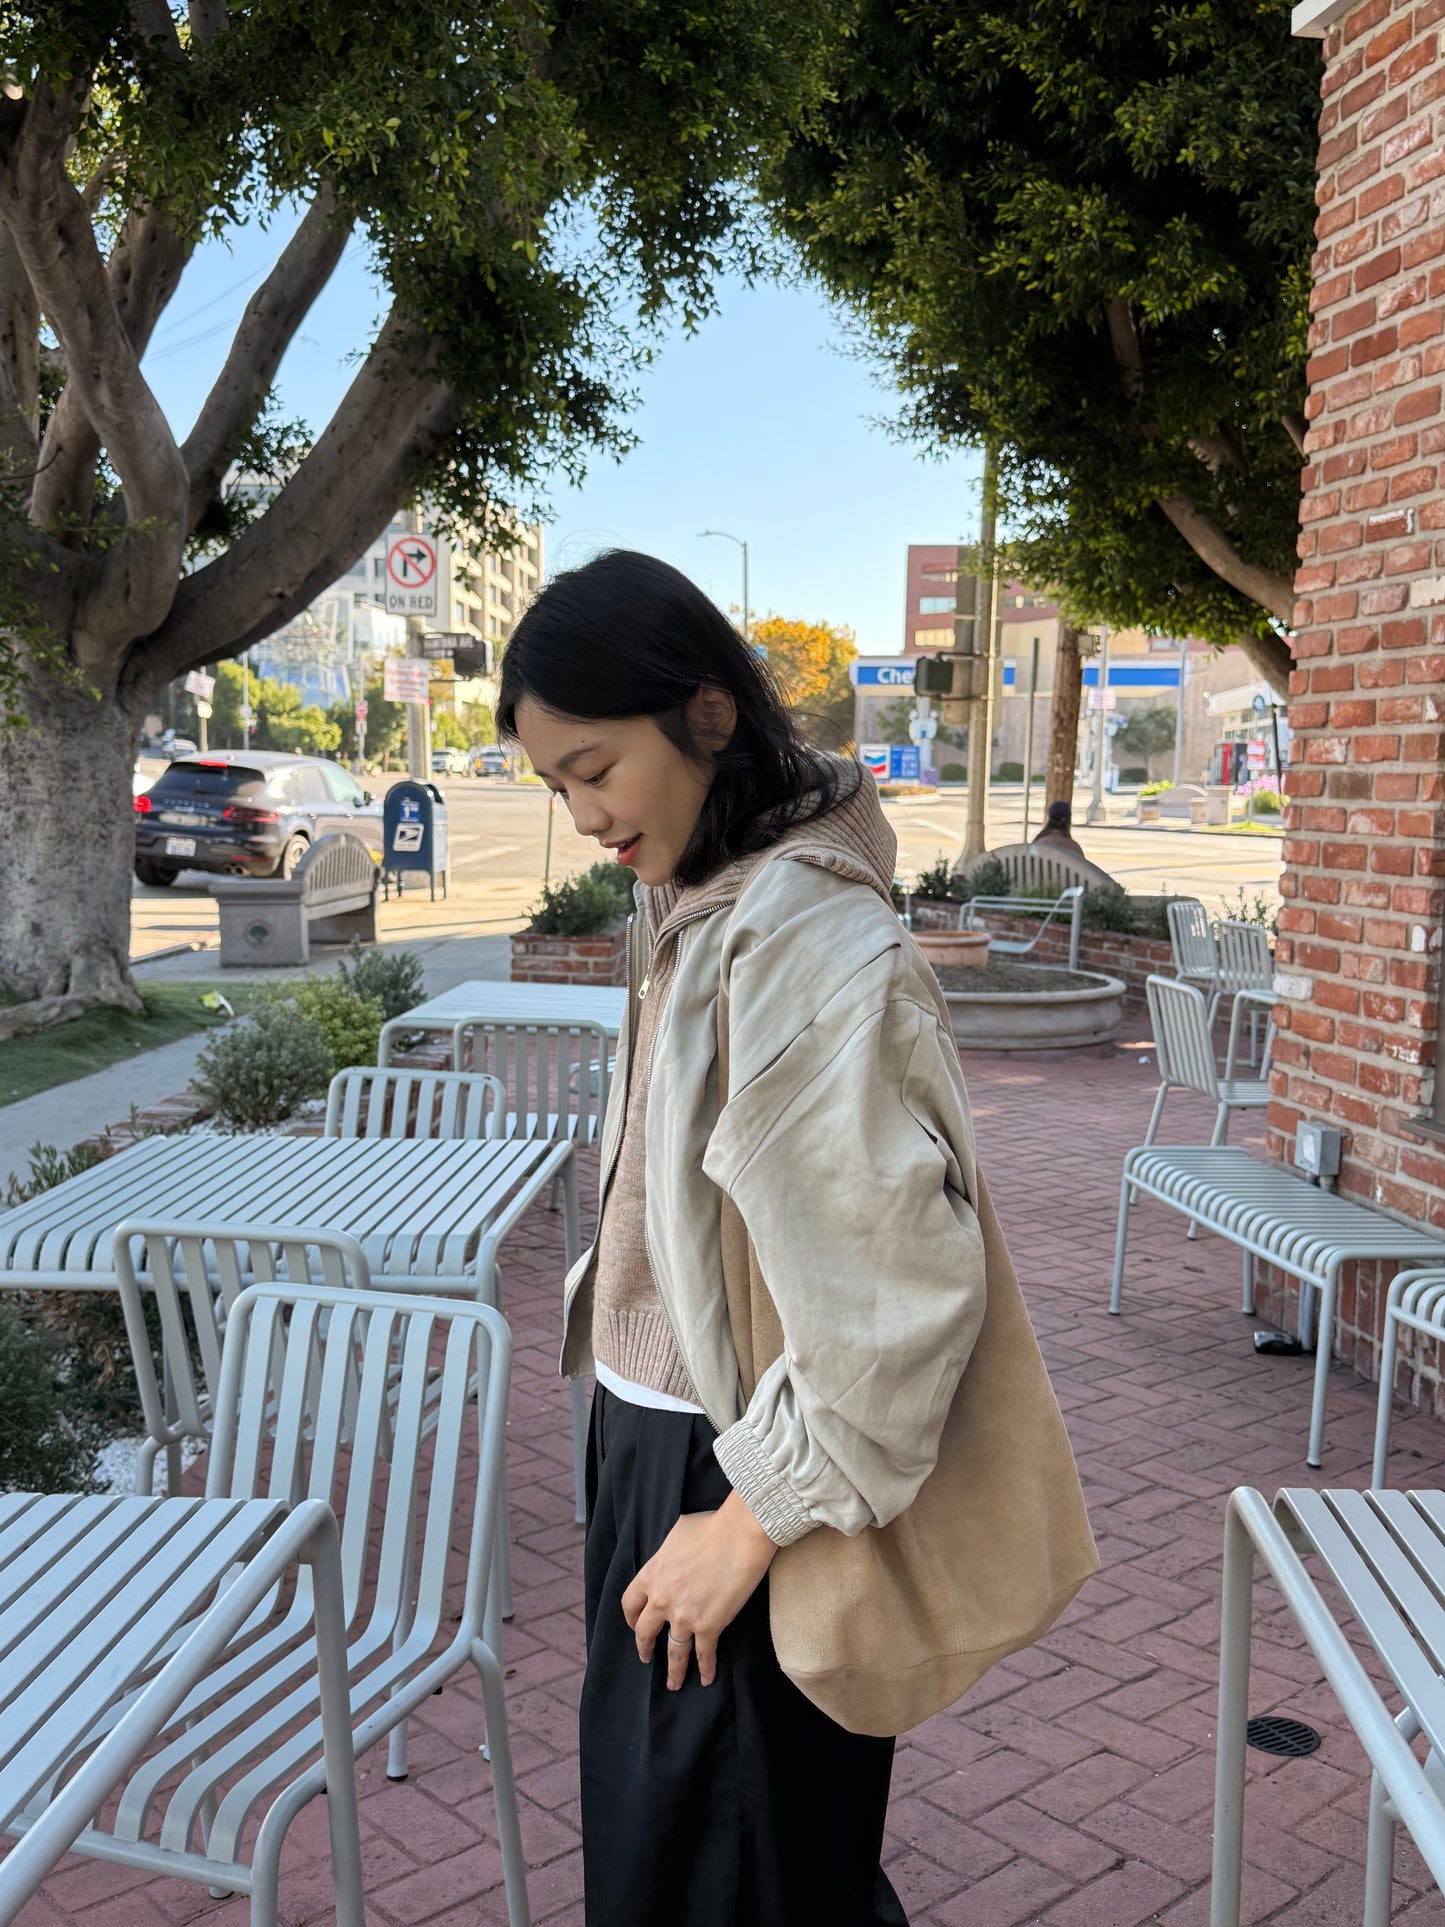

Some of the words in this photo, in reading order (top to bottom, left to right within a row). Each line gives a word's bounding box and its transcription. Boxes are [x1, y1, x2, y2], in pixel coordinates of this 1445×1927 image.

[389, 595, 405, 609] ON
[408, 595, 433, 610] RED
[876, 667, 915, 685] Che
